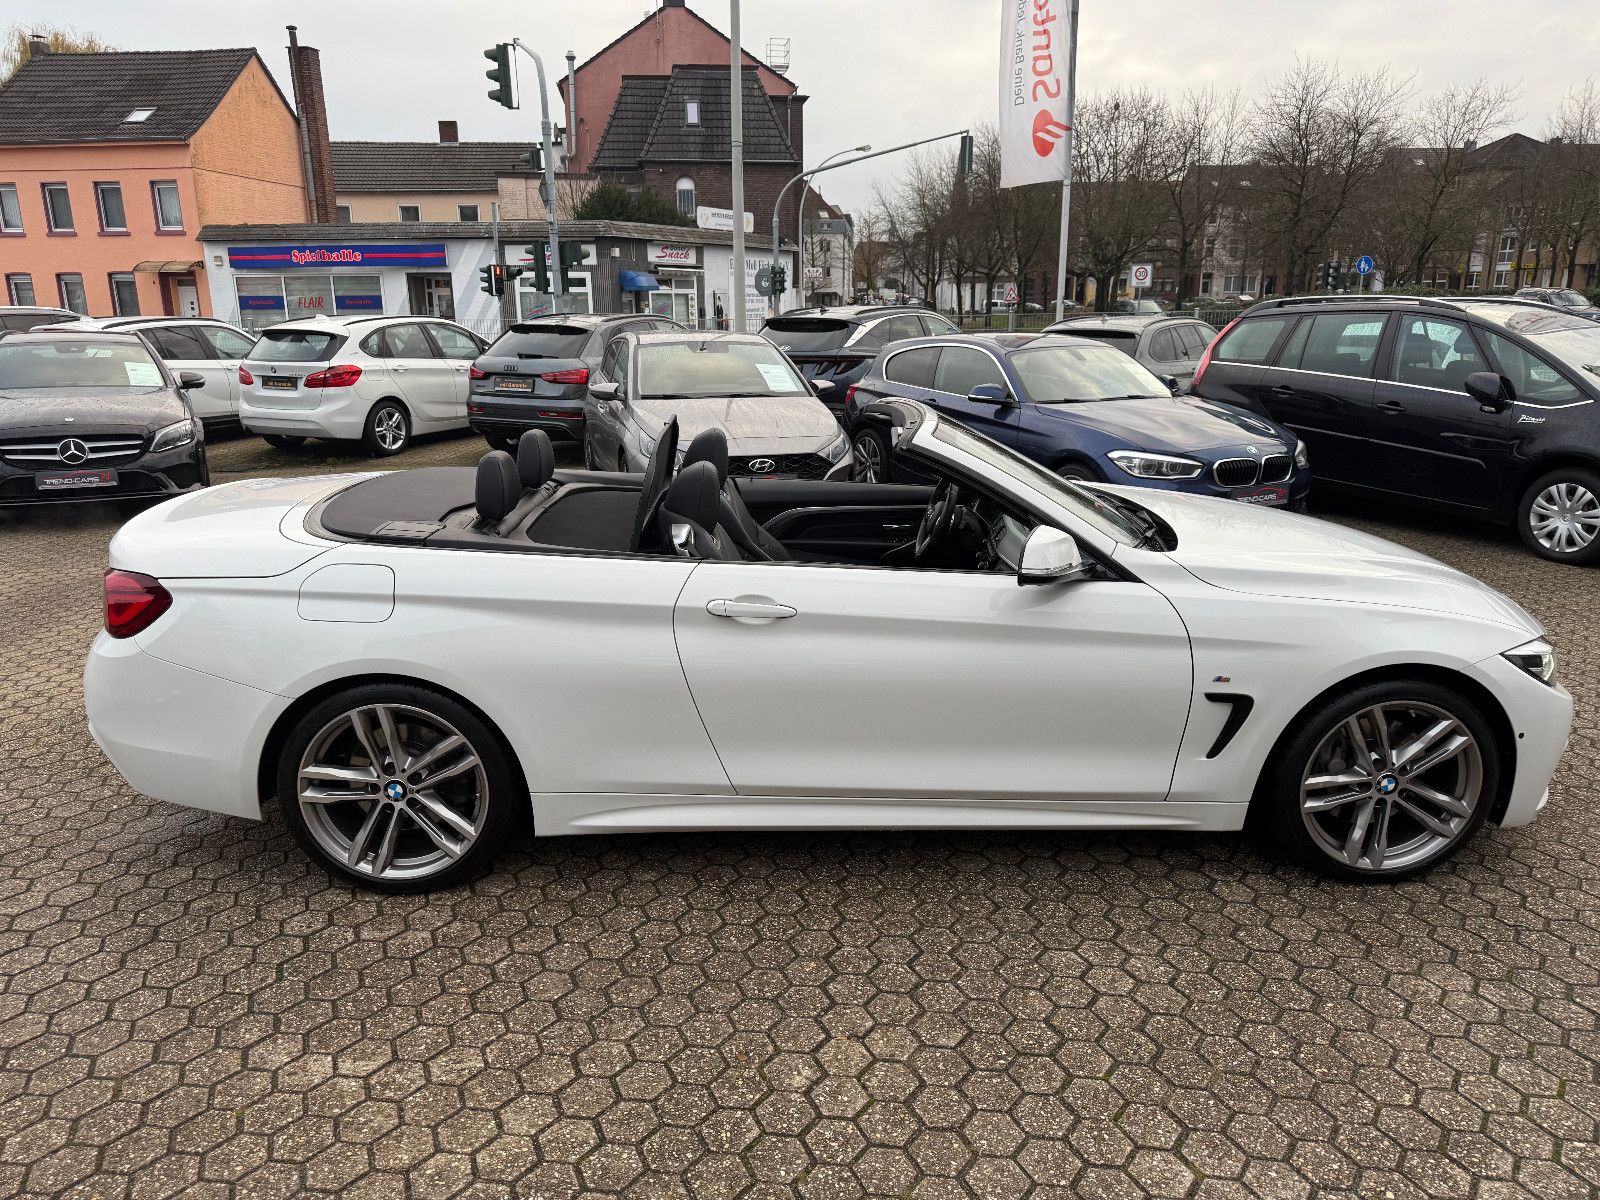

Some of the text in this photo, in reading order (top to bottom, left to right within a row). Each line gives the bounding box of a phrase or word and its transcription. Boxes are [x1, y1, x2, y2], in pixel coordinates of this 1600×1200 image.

[291, 249, 362, 264] Spielhalle
[655, 244, 690, 260] Snack
[298, 296, 324, 309] FLAIR
